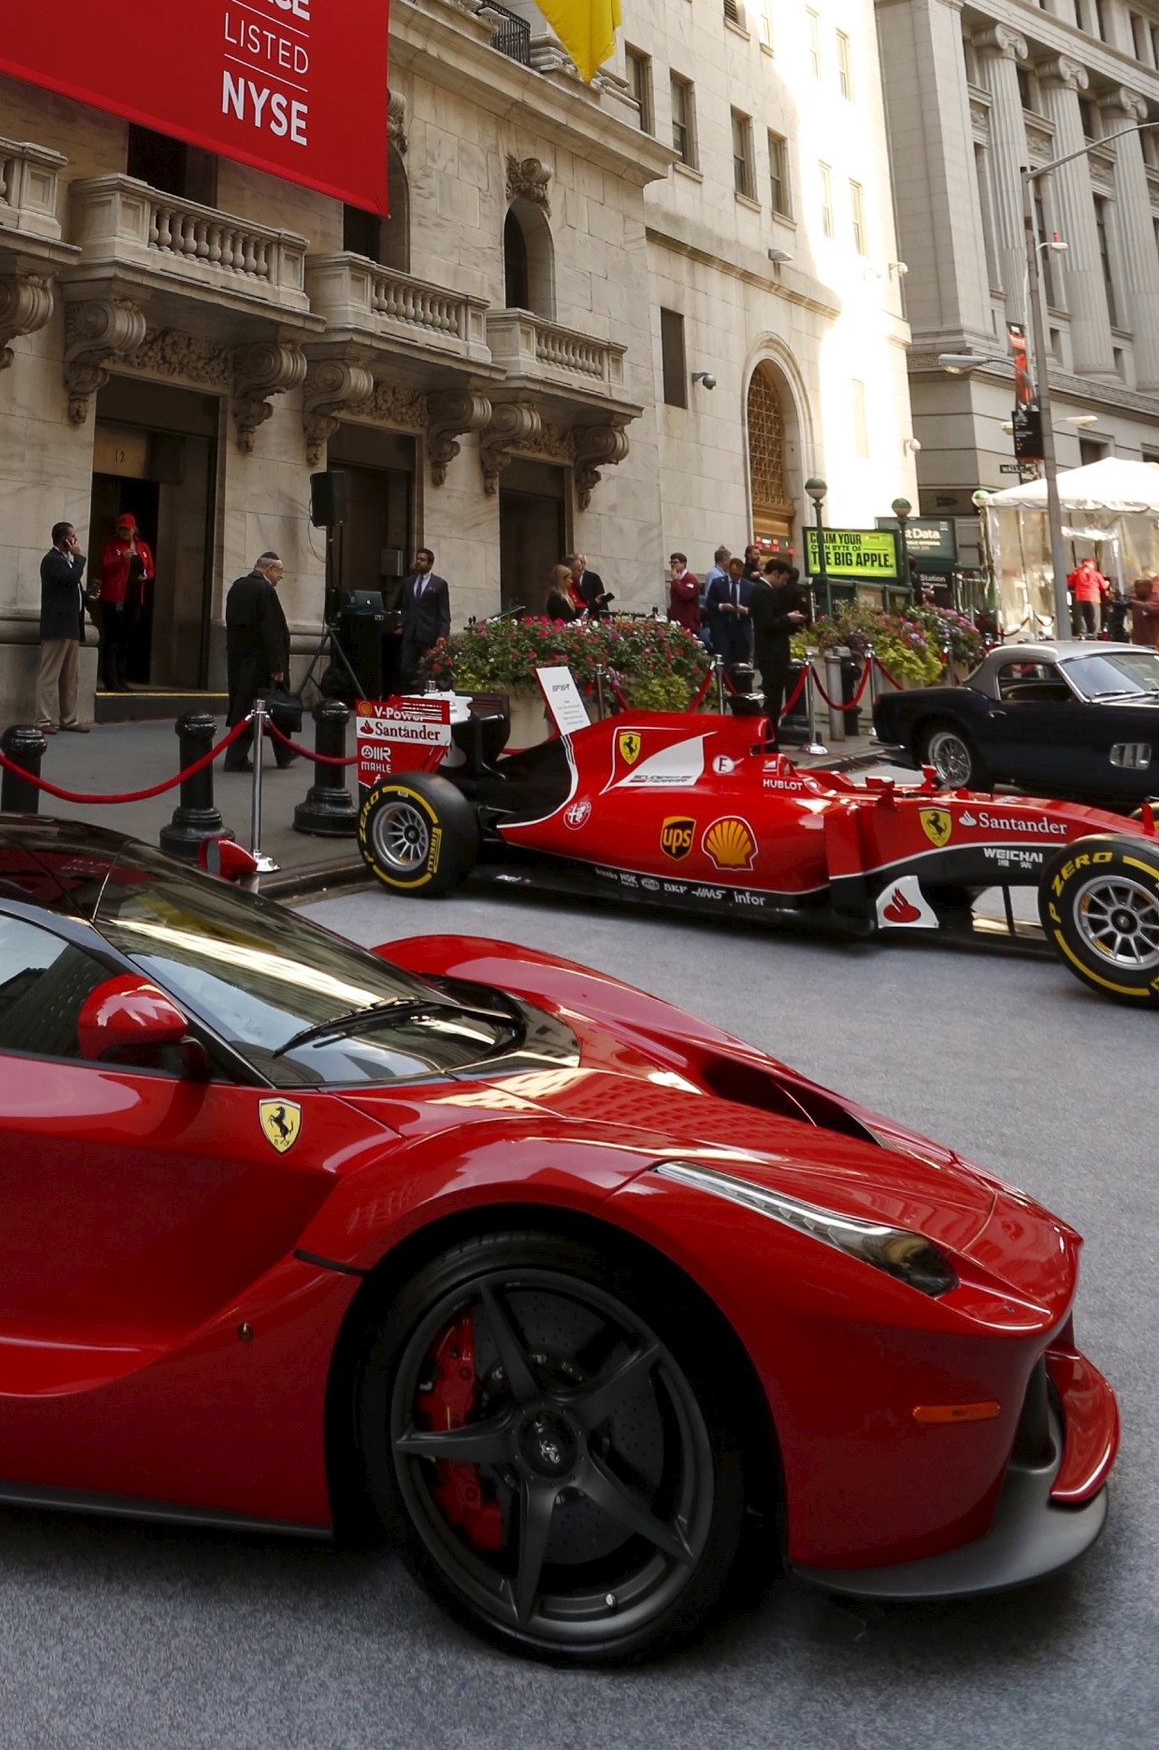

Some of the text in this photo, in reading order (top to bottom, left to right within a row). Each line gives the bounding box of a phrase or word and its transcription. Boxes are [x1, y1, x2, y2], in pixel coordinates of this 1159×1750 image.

[224, 11, 310, 75] LISTED
[221, 69, 309, 146] NYSE
[810, 532, 836, 544] CIM
[838, 533, 862, 545] YOUR
[812, 551, 894, 568] TE BIG APPLE.
[920, 574, 946, 582] Station
[375, 721, 441, 741] Santander
[361, 761, 392, 774] MAHLE
[763, 778, 803, 791] HUBLOT
[359, 791, 379, 844] ZERO
[978, 812, 1068, 835] Santander
[662, 828, 691, 854] ups
[983, 847, 1043, 863] WEICHAI
[1048, 851, 1113, 923] P ZERO
[734, 891, 766, 906] infor
